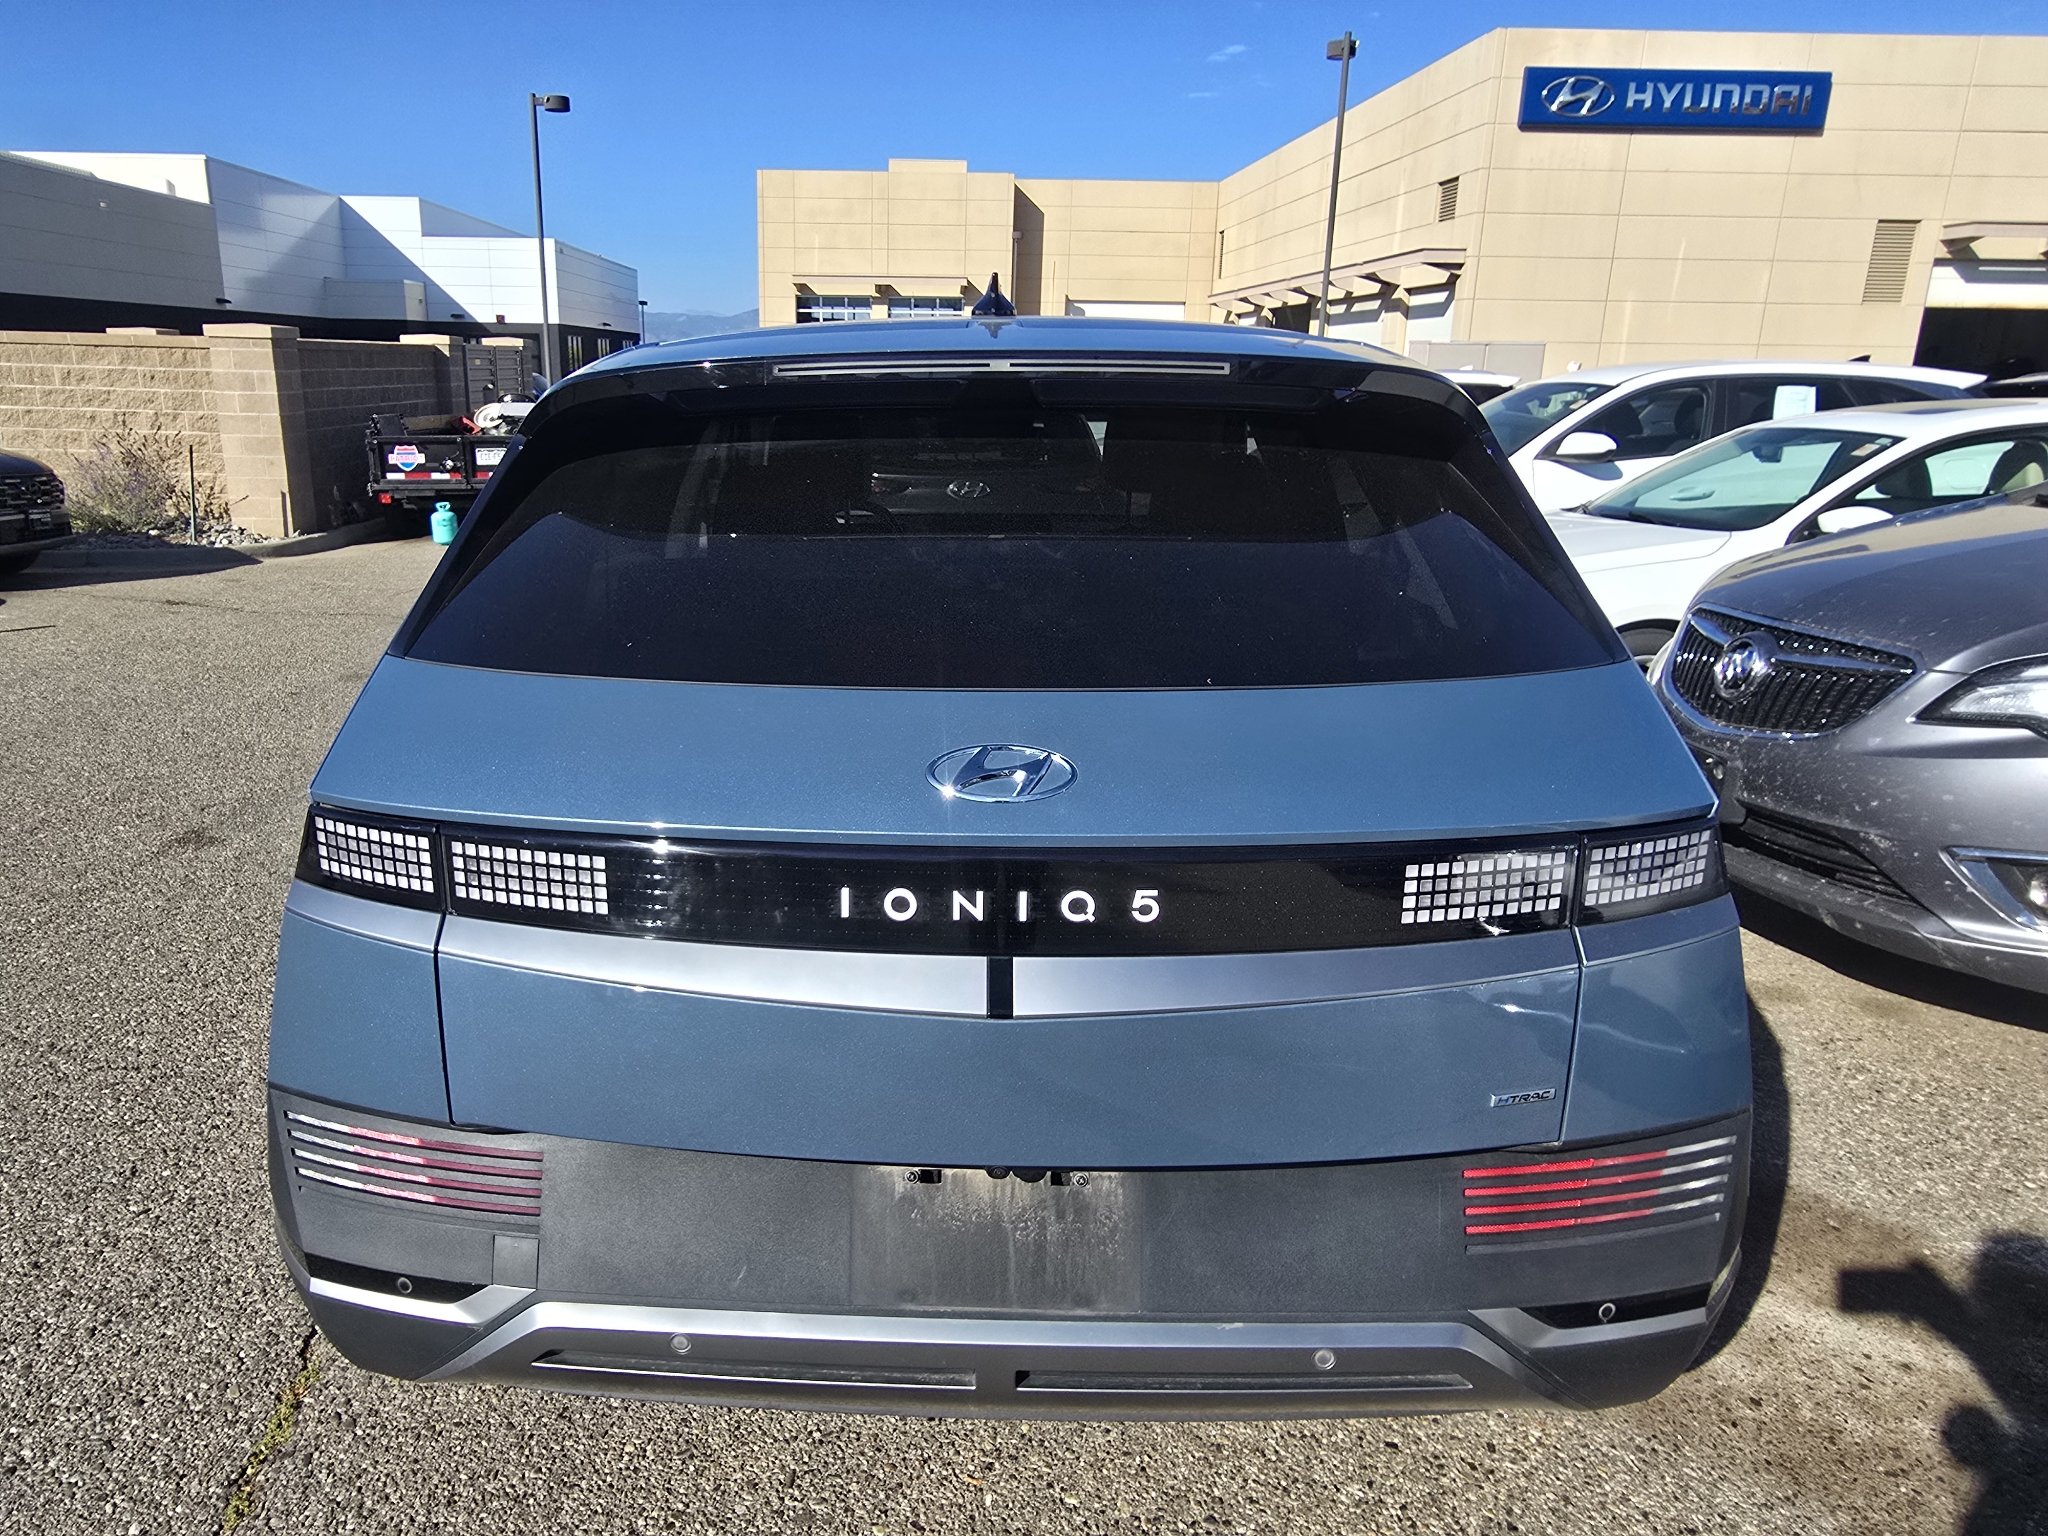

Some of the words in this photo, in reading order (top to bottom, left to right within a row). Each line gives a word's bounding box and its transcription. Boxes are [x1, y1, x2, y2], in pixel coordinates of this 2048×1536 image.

[1625, 81, 1814, 116] HYUNDAI
[839, 886, 1097, 923] IONIQ
[1130, 888, 1161, 923] 5
[1496, 1090, 1551, 1105] HTRAC
